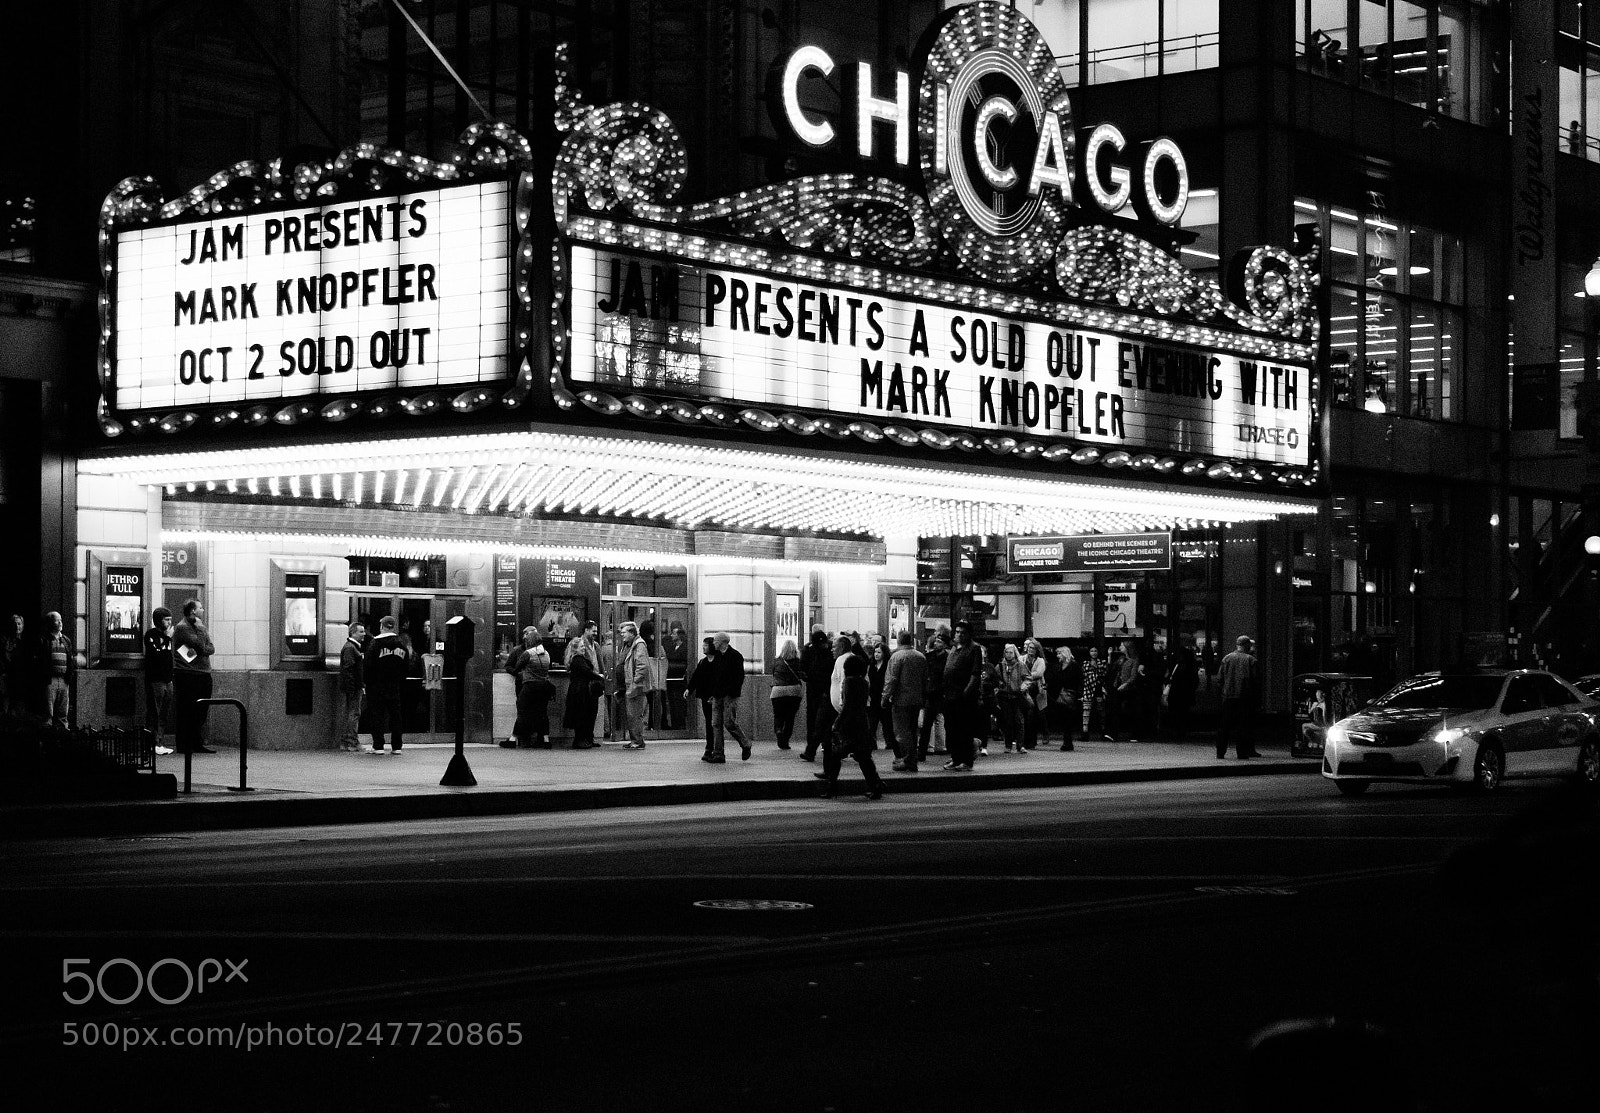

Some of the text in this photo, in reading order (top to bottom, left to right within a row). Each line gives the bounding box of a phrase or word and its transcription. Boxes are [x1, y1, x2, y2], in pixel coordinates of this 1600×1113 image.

[782, 45, 1189, 223] CHICAGO
[1518, 87, 1552, 266] Walgreens
[181, 199, 427, 265] JAM PRESENTS
[174, 264, 438, 327] MARK KNOPFLER
[180, 328, 431, 386] OCT 2 SOLD OUT
[598, 258, 1298, 411] JAM PRESENTS A SOLD OUT EVENING WITH
[860, 358, 1126, 440] MARK KNOPFLER
[106, 574, 139, 584] JETHRO
[550, 569, 576, 577] CHICAGO
[550, 576, 576, 584] THEATRE
[1019, 548, 1058, 556] CHICAGO
[112, 584, 134, 593] TULL
